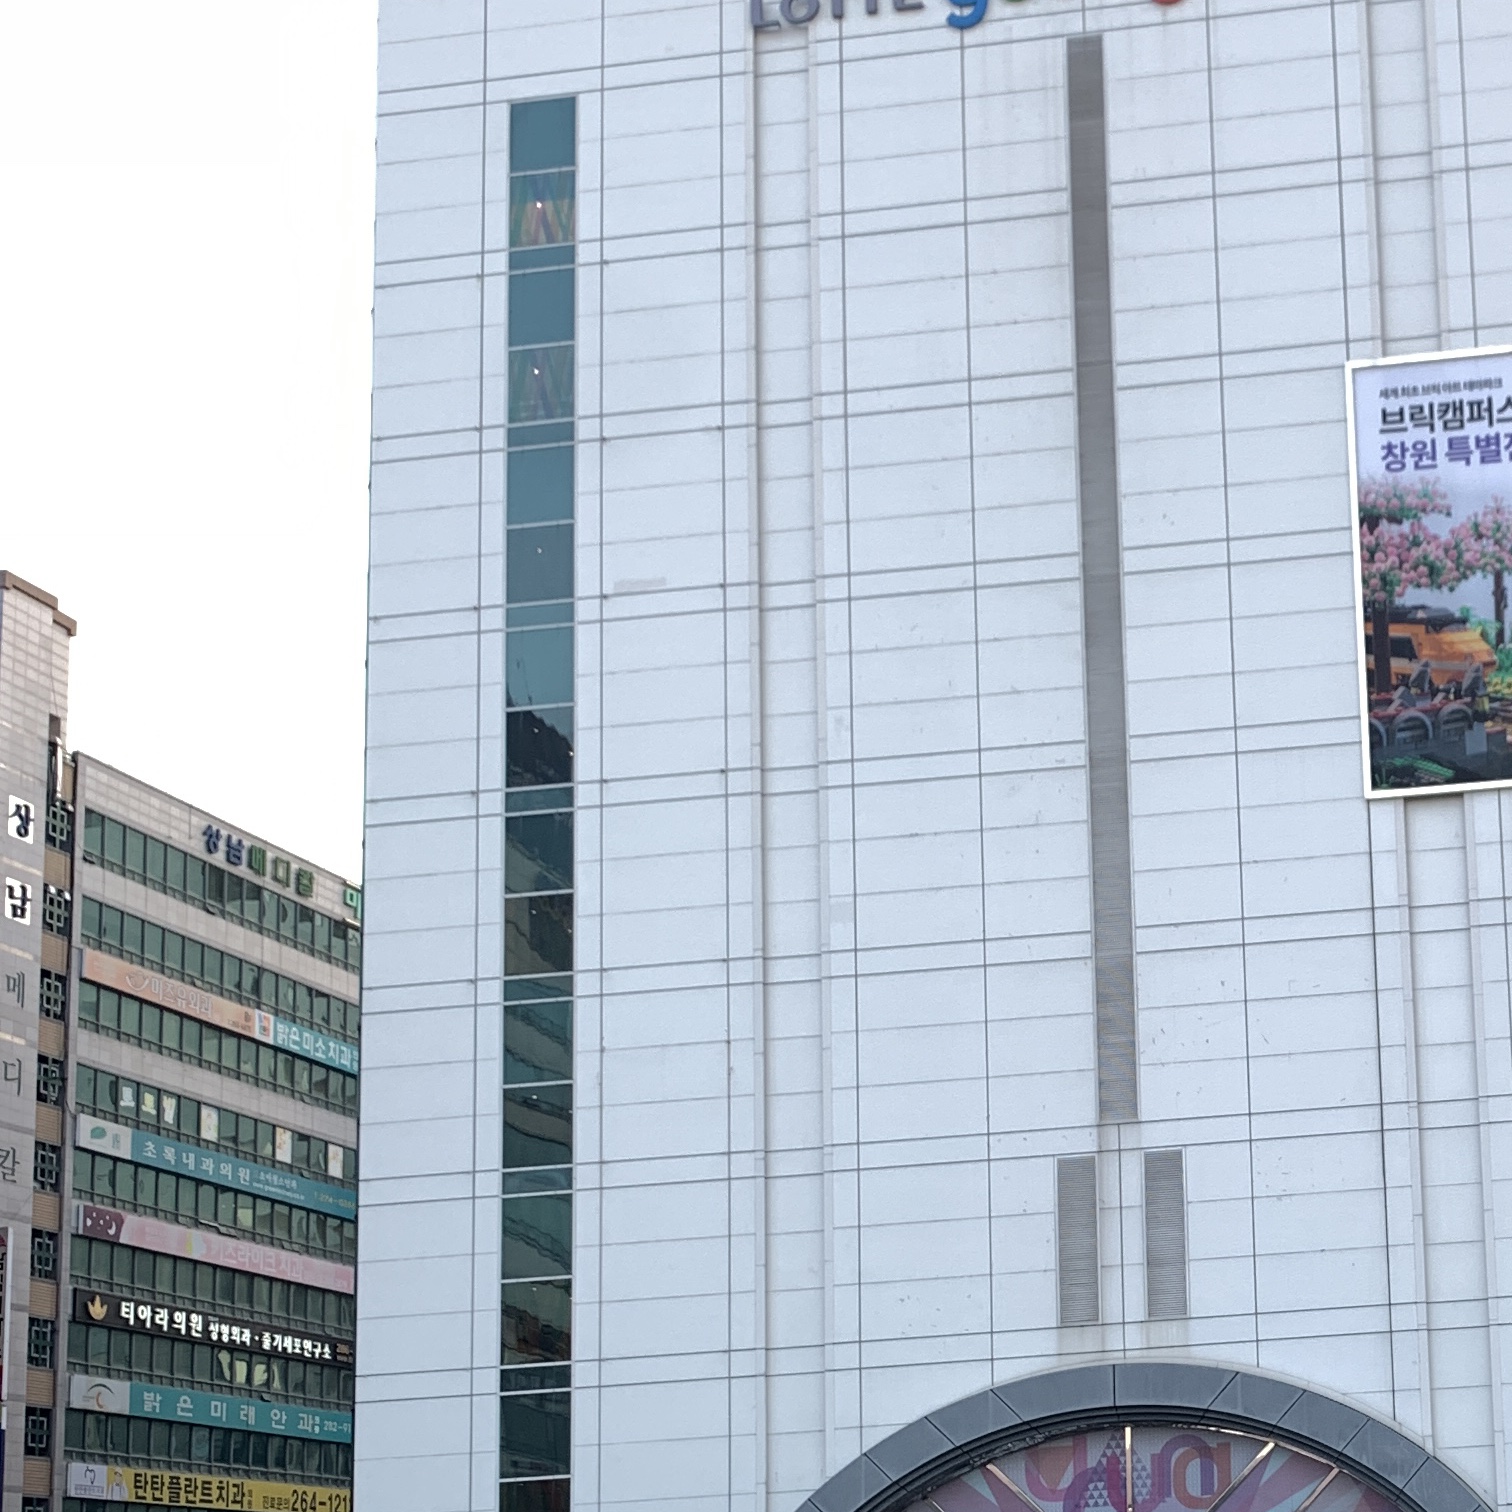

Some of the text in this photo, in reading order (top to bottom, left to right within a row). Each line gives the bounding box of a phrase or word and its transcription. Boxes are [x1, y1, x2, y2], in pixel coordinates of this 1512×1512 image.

[1380, 437, 1438, 473] 창원
[276, 1021, 351, 1069] 밝은미소치과
[143, 1141, 250, 1185] 초록내과의원
[120, 1301, 202, 1337] 티아라의원
[208, 1322, 251, 1347] 성형외과
[261, 1331, 332, 1359] 줄기세포연구소
[143, 1391, 314, 1432] 밝은미래안과
[133, 1472, 245, 1509] 탄탄플란트치과
